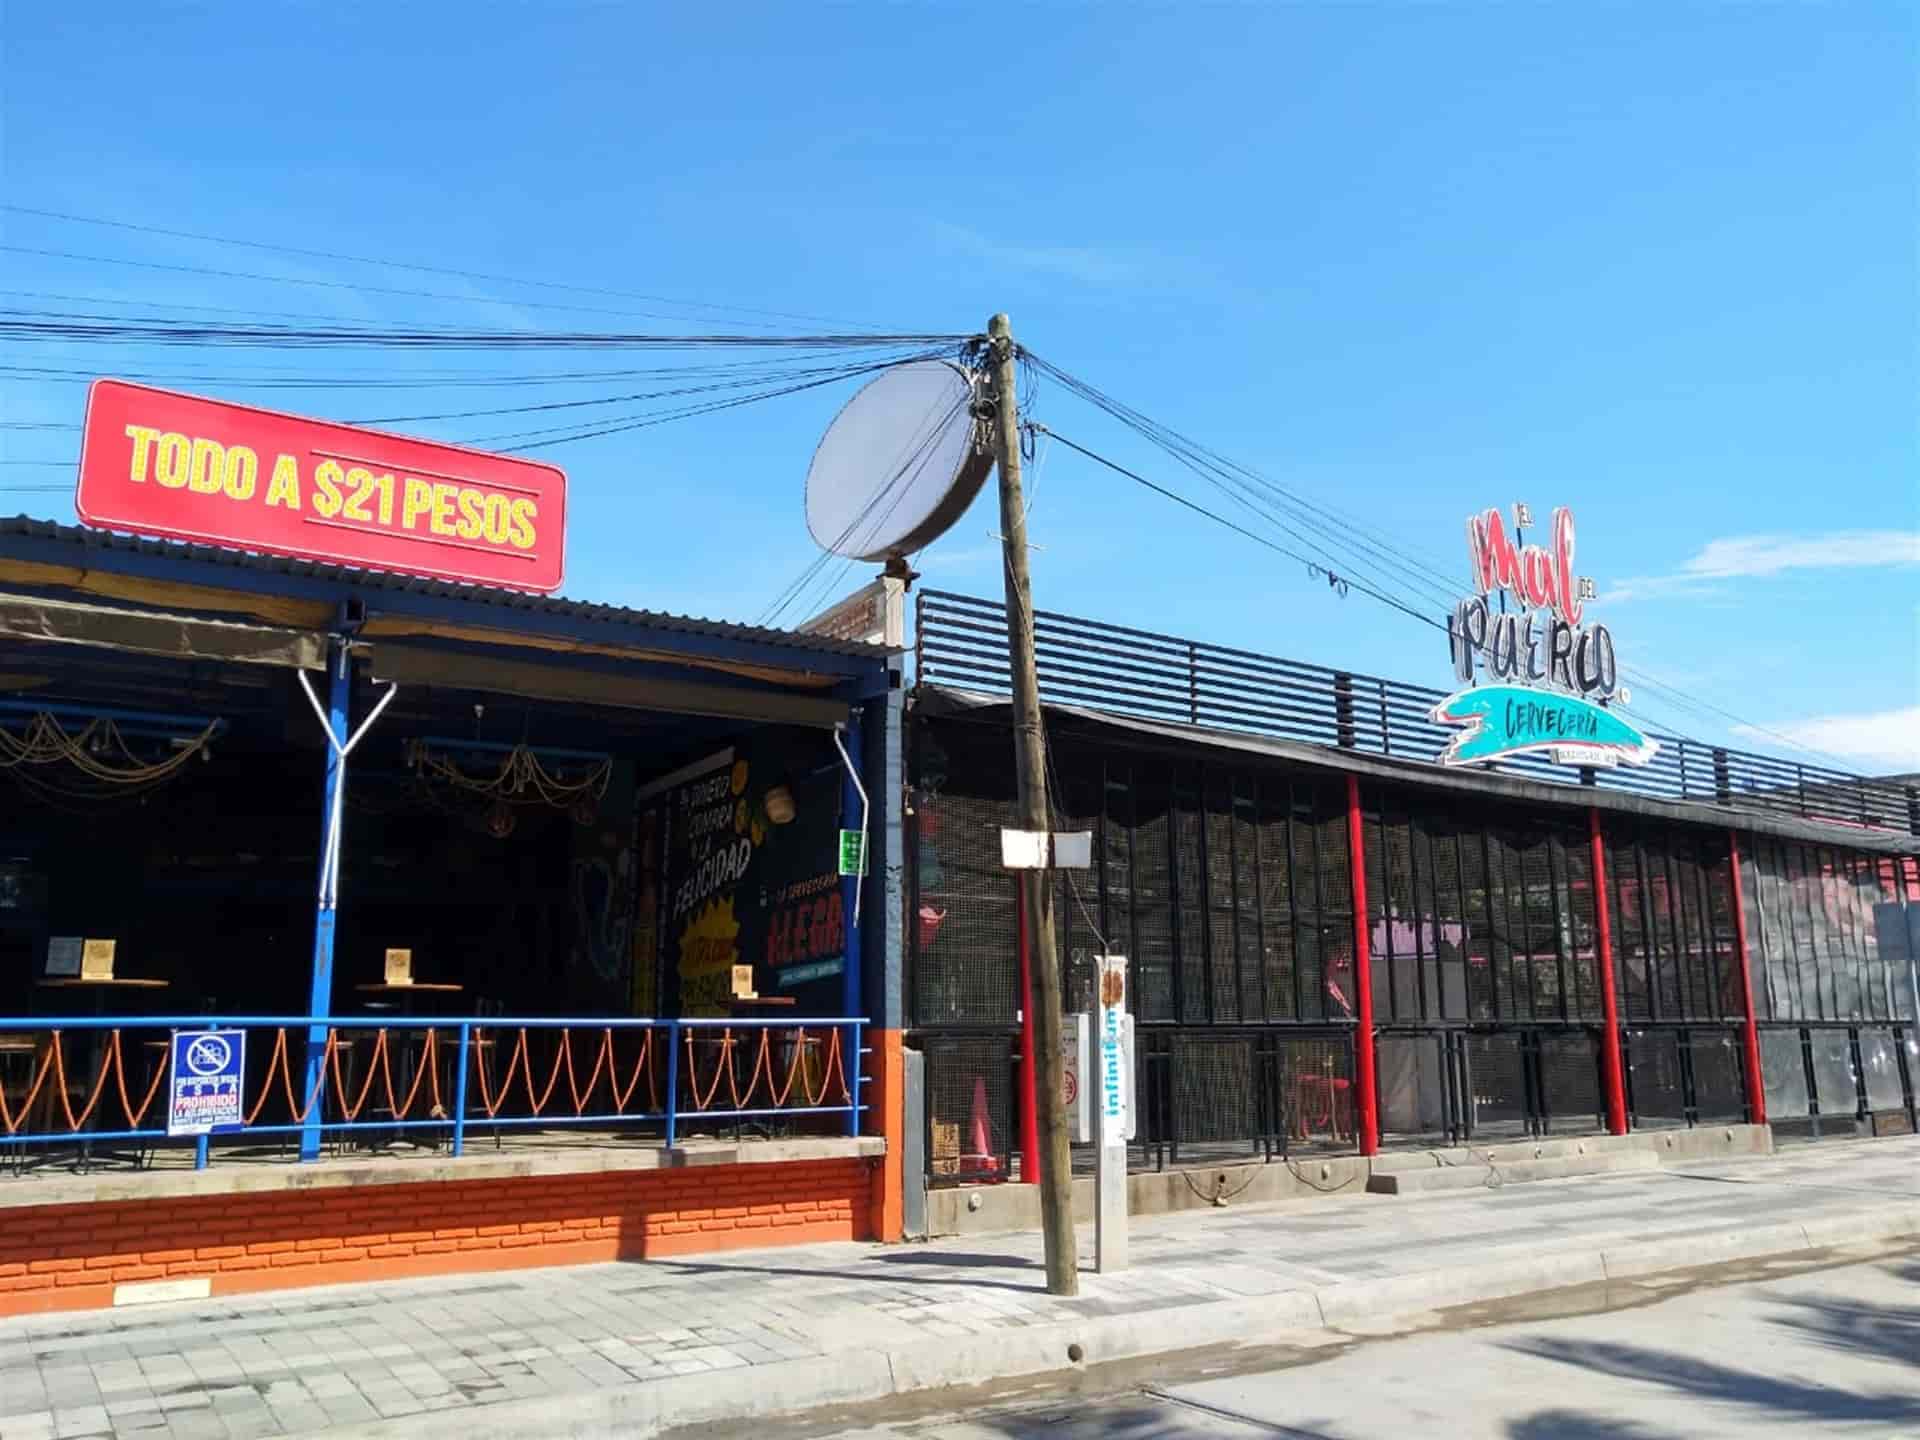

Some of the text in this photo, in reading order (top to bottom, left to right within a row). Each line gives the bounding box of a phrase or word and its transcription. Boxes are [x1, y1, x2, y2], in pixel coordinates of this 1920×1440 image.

[125, 424, 538, 549] TODO A $21 PESOS
[1515, 502, 1534, 527] EL
[1578, 577, 1598, 599] DEL
[1458, 598, 1617, 696] PUERCO
